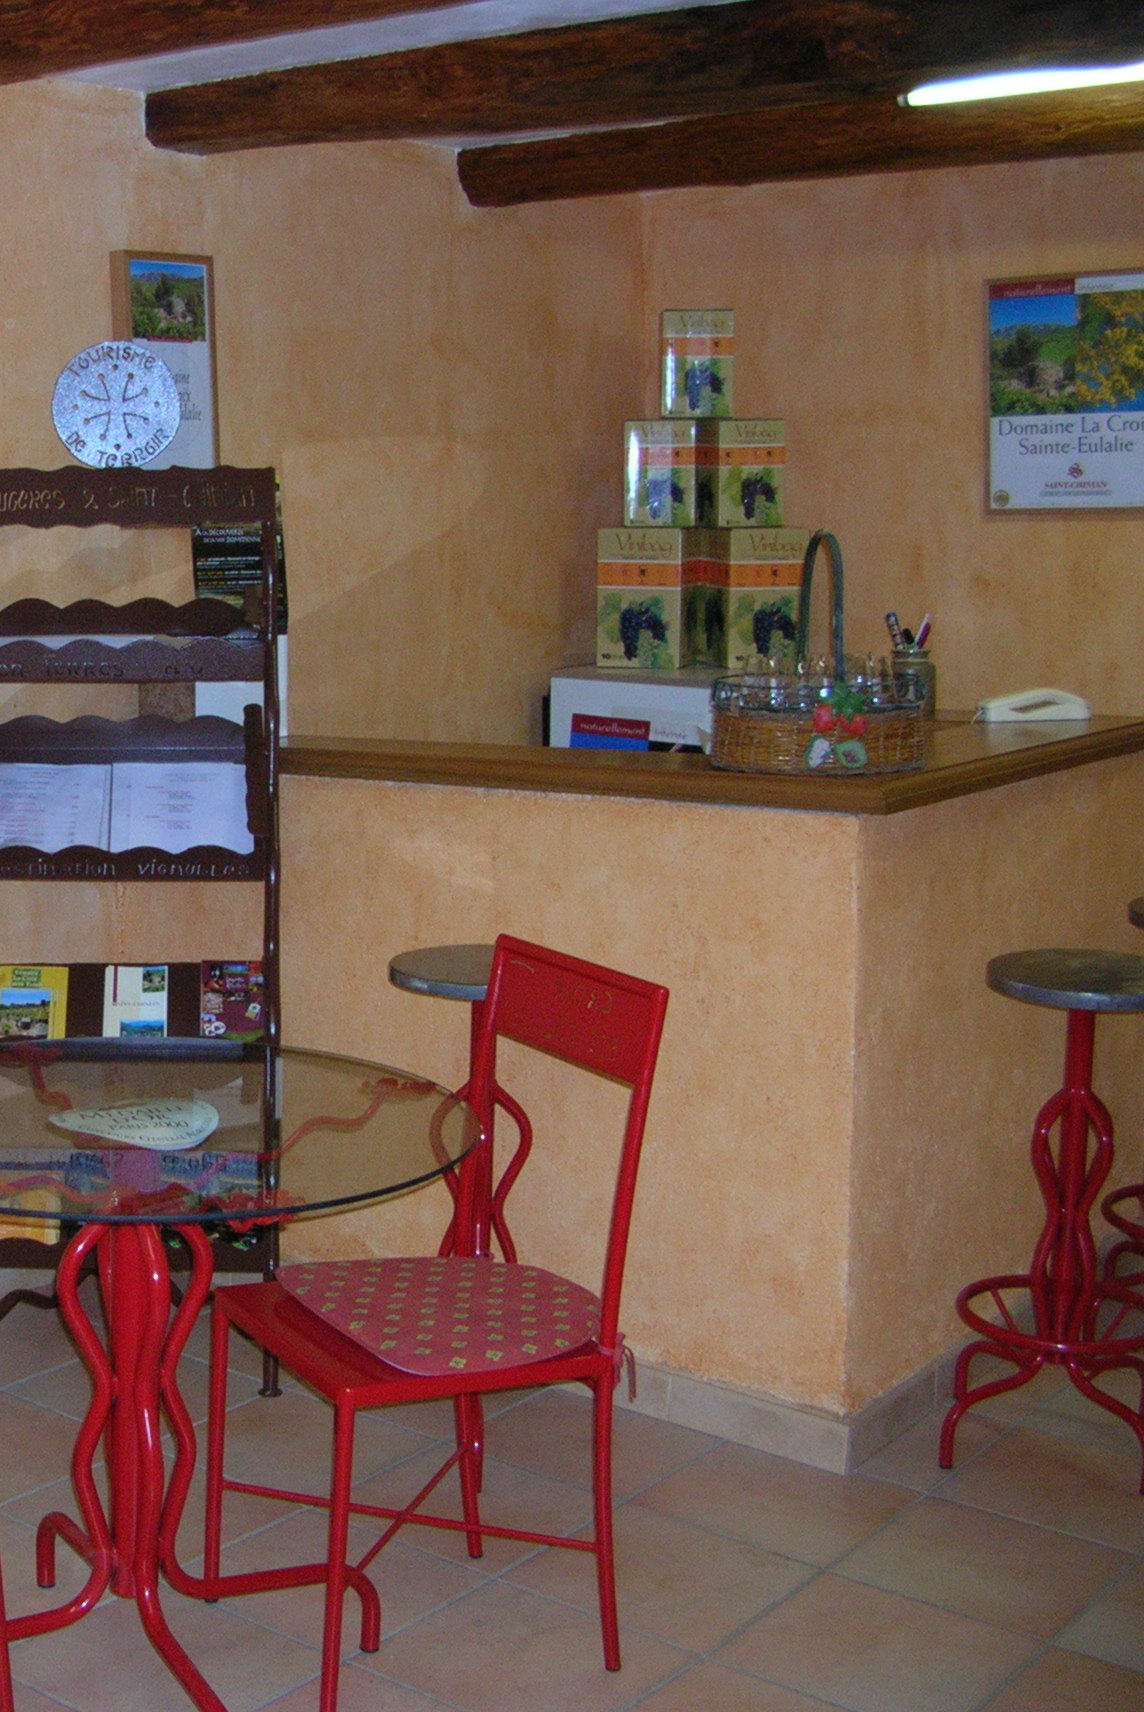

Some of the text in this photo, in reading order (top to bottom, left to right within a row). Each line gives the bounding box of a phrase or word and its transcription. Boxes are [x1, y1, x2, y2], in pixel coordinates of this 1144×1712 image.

[998, 419, 1074, 436] Domaine
[1081, 416, 1100, 433] La
[1018, 436, 1134, 456] Sainte-Eulalie
